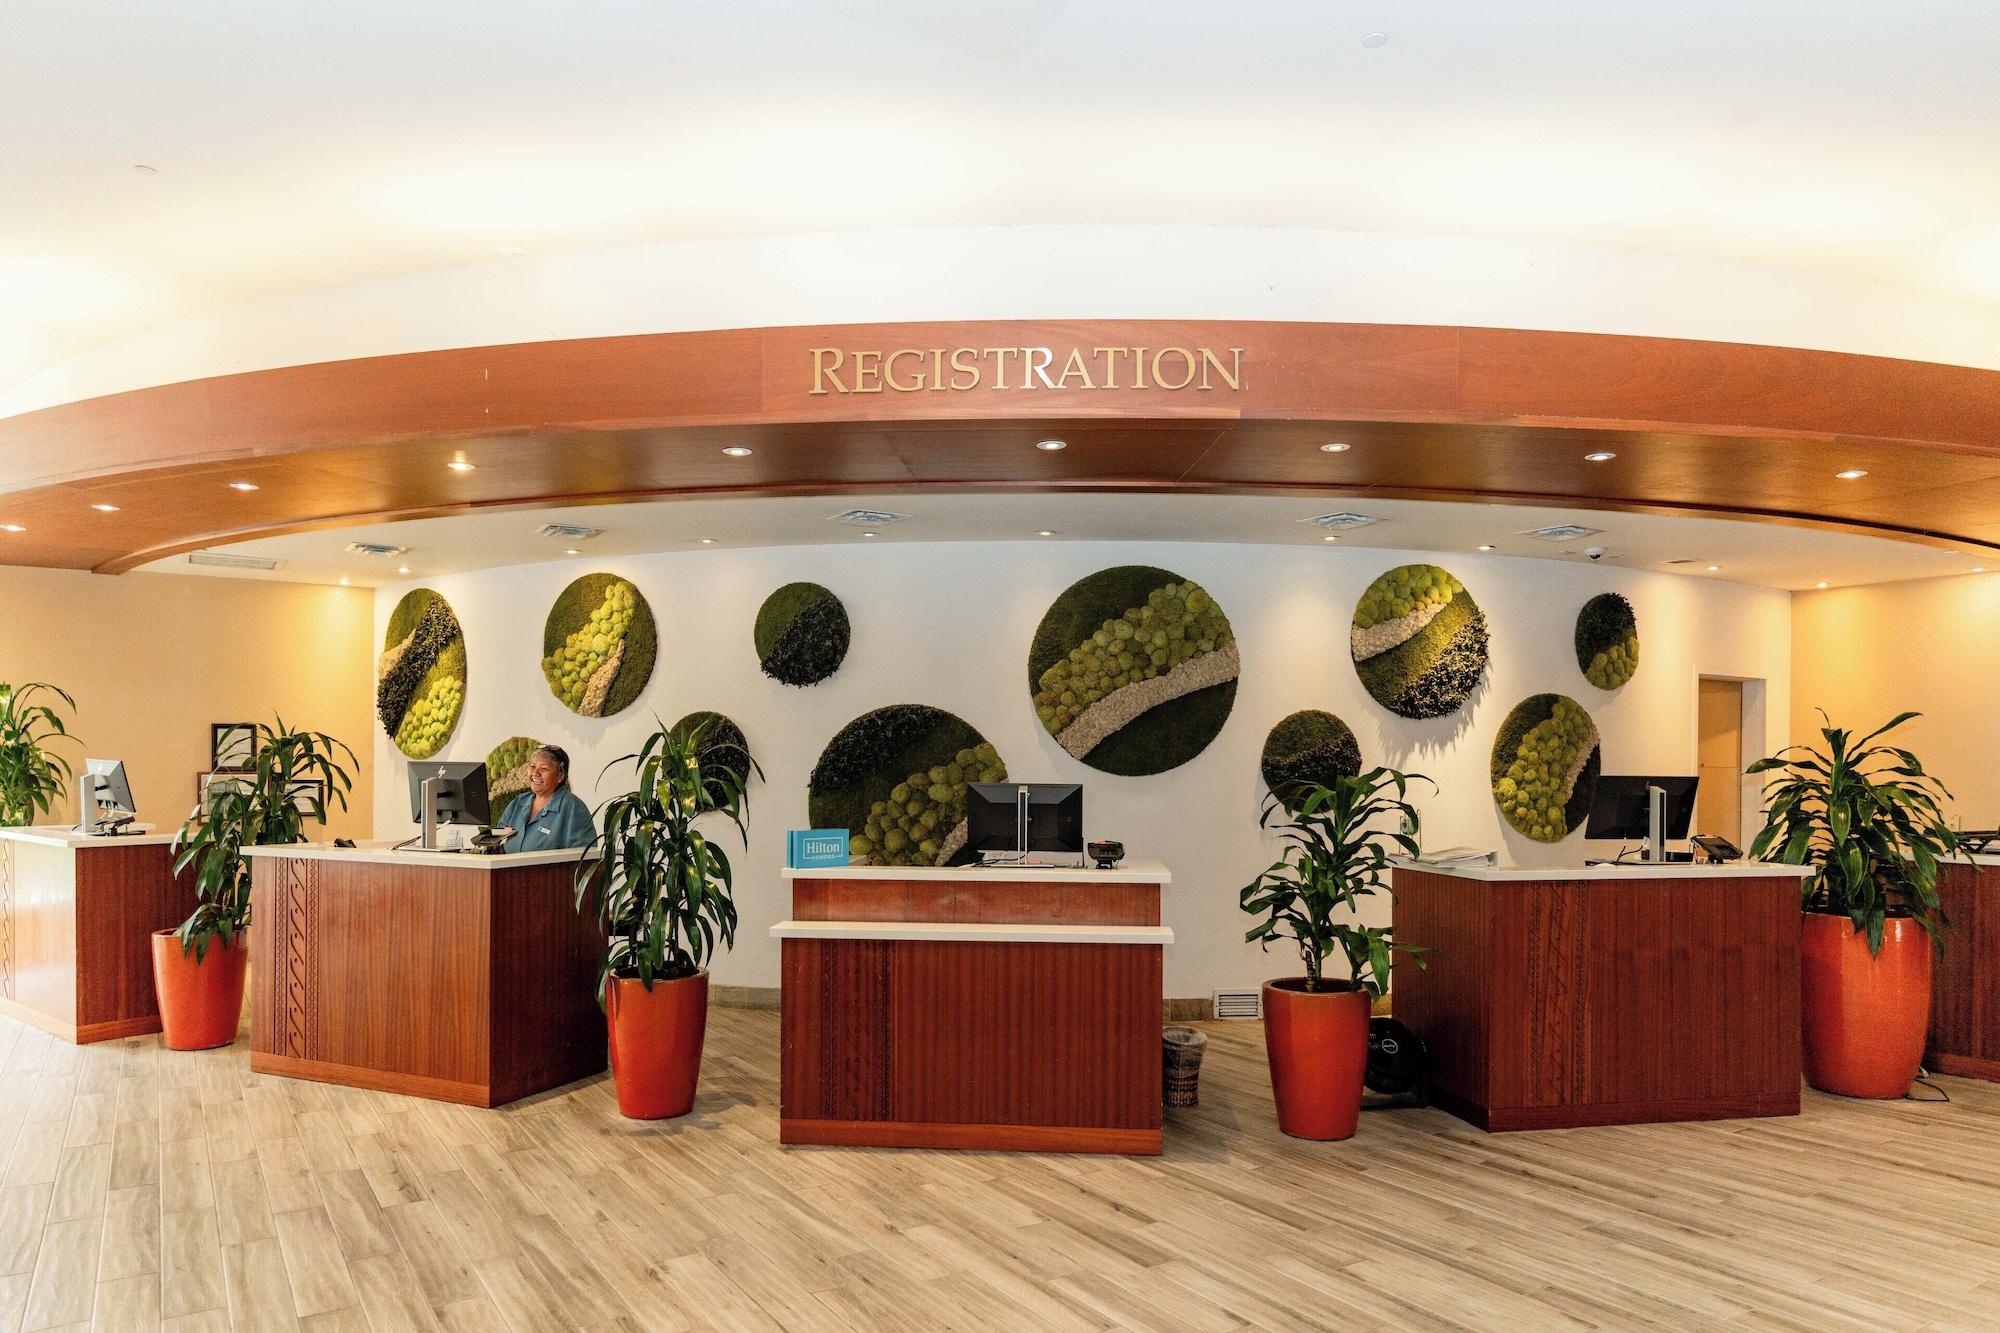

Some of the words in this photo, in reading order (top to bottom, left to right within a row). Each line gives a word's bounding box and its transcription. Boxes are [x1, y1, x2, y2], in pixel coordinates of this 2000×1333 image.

[809, 347, 1244, 395] REGISTRATION
[806, 841, 840, 854] Hilton
[811, 853, 836, 861] HONORS
